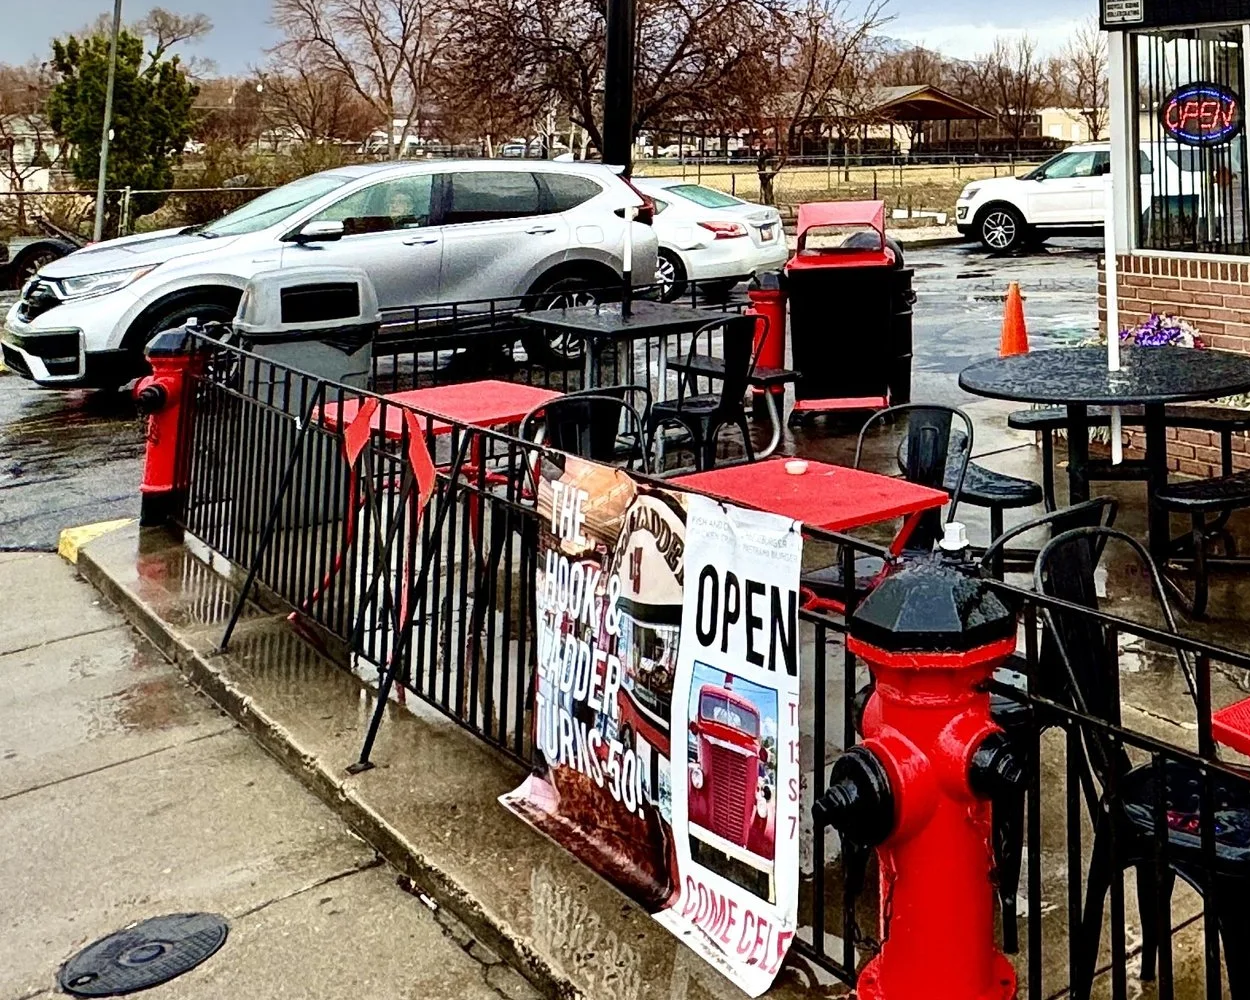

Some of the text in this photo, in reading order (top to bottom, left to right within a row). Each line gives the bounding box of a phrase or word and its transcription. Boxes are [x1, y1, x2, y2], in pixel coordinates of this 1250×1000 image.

[1165, 100, 1235, 129] OPEN
[551, 480, 589, 546] THE
[545, 549, 601, 628] HOOK
[605, 574, 624, 635] &
[696, 564, 797, 677] OPEN
[537, 610, 622, 719] LADDER
[536, 692, 604, 788] TURNS
[682, 874, 738, 944] COME
